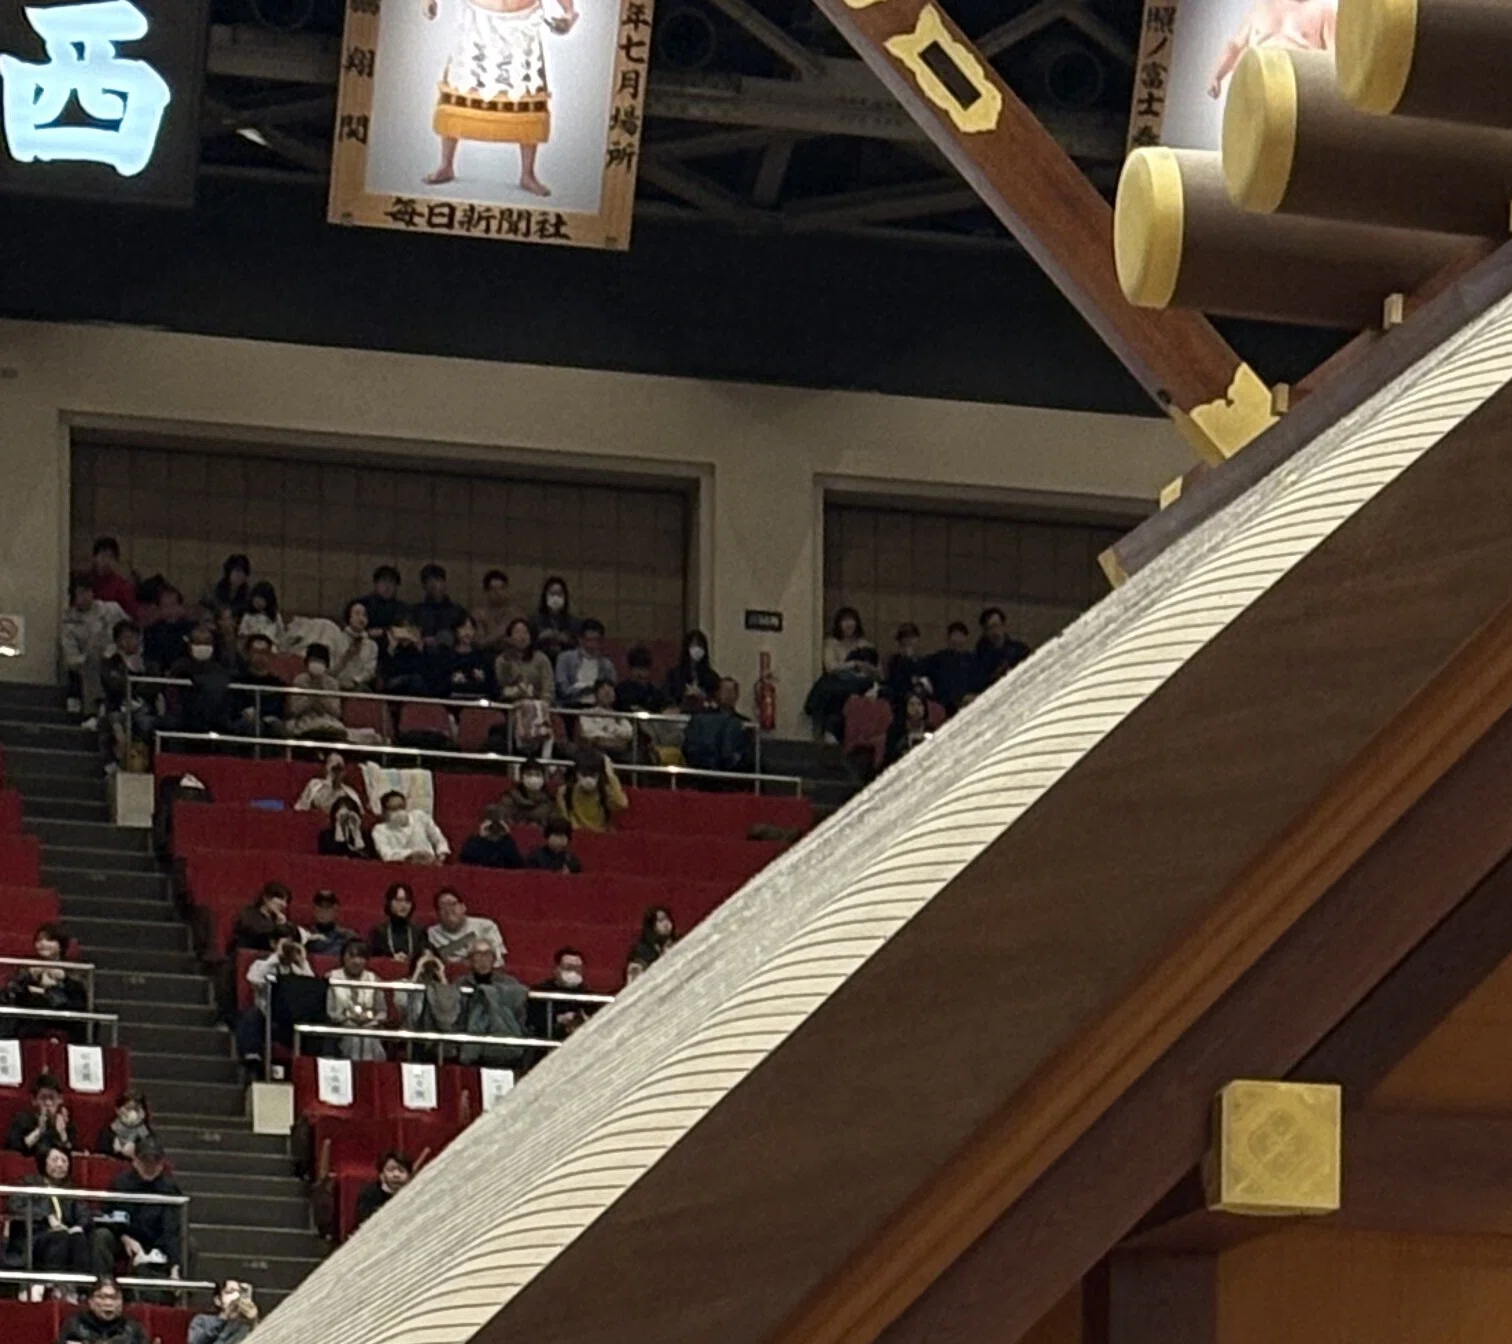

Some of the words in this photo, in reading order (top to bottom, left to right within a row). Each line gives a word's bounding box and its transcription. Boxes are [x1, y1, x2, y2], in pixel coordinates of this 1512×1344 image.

[0, 0, 171, 177] 西
[384, 196, 571, 241] 毎日新聞社
